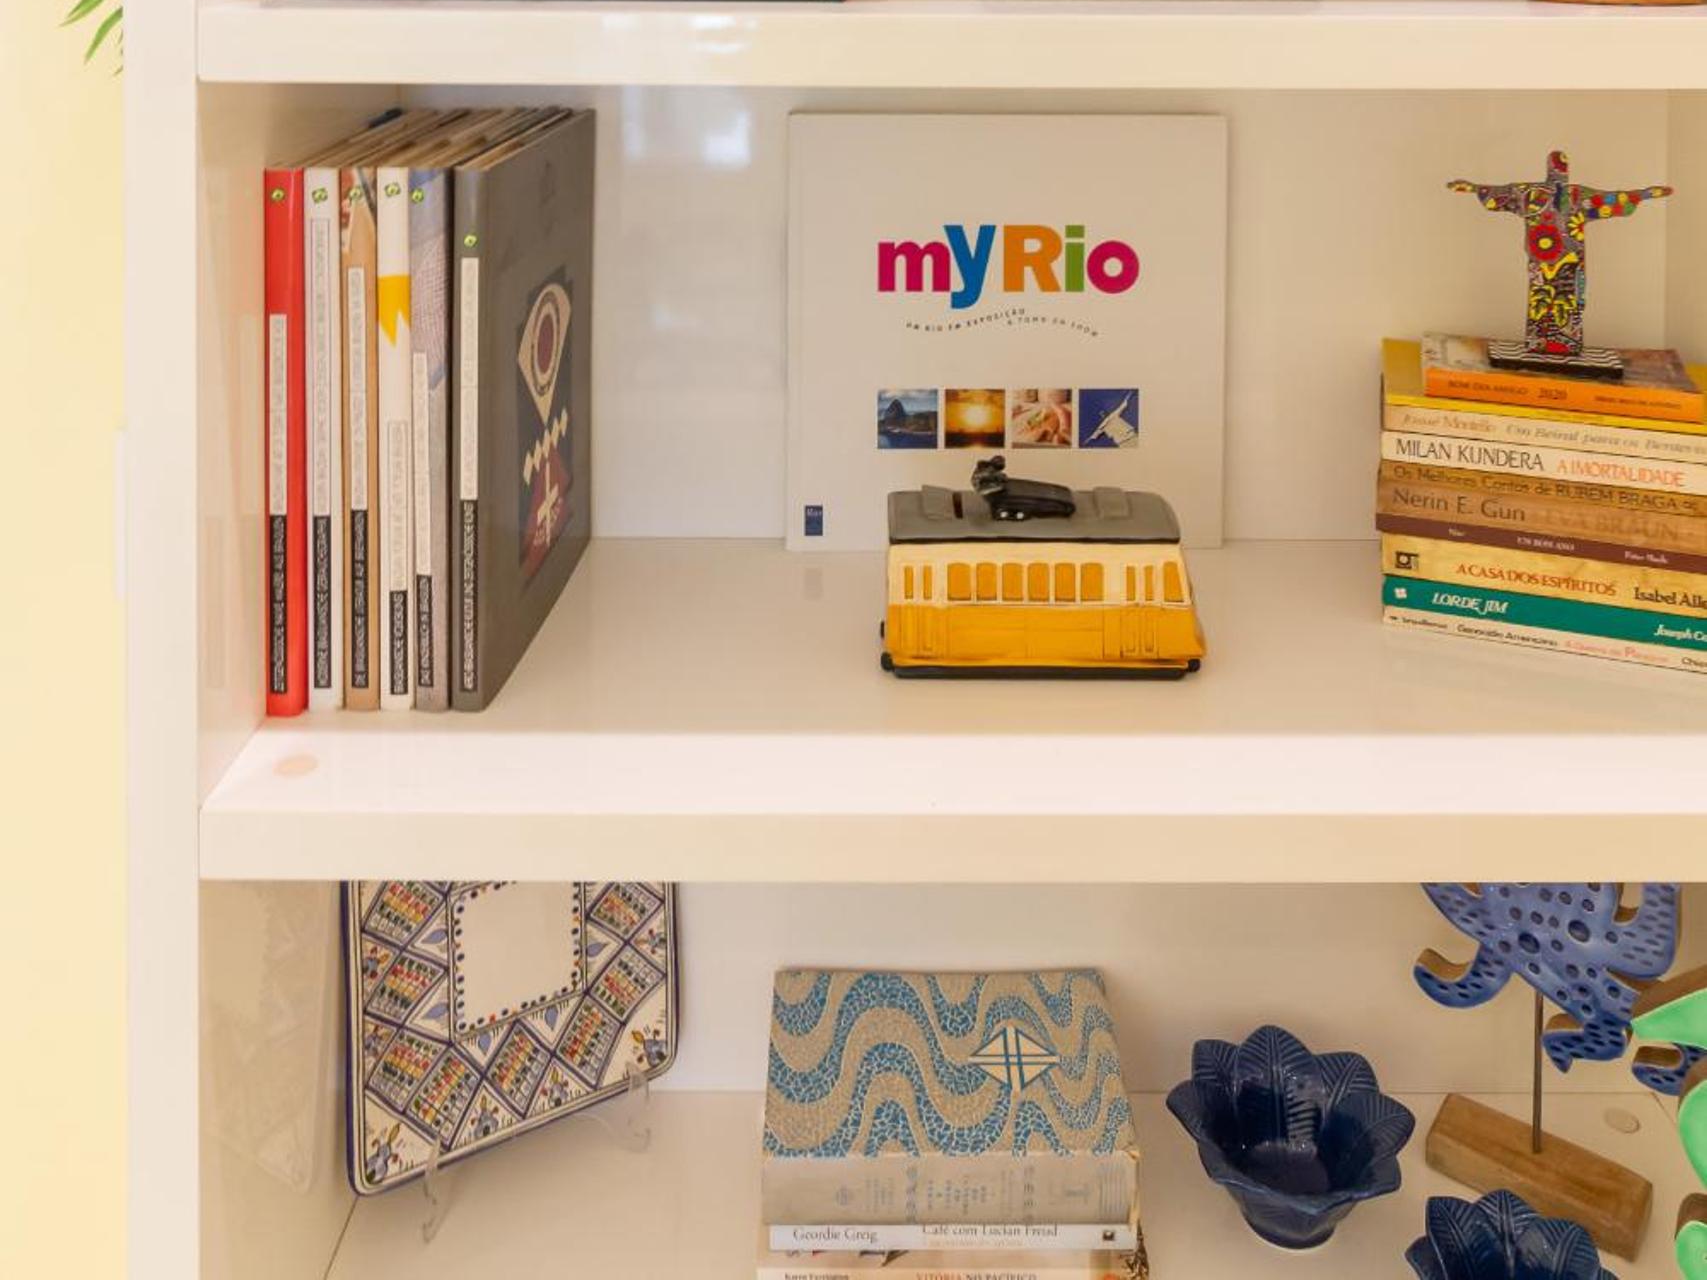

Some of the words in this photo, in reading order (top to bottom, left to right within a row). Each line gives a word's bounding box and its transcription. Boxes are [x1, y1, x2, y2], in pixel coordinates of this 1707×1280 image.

[1395, 438, 1452, 461] MILAN
[1457, 445, 1544, 471] KUNDERA
[1557, 458, 1567, 474] A
[1571, 460, 1686, 488] IMORTALIDADE
[1392, 487, 1449, 512] Nerin
[1481, 497, 1526, 522] Gun
[1482, 476, 1531, 493] Contos
[1555, 483, 1614, 504] RUBEM
[1617, 490, 1677, 510] BRAGA
[1456, 563, 1467, 576] A
[1468, 564, 1505, 582] CASA
[1507, 569, 1540, 587] DOS
[1541, 574, 1617, 596] ESPÍRITOS
[1633, 586, 1677, 605] Isabel
[1432, 592, 1483, 610] LORDE
[1476, 600, 1509, 615] JIM
[1654, 624, 1693, 641] Joseph
[793, 1226, 840, 1241] Geordie
[843, 1228, 878, 1244] Greig
[951, 1226, 978, 1236] com
